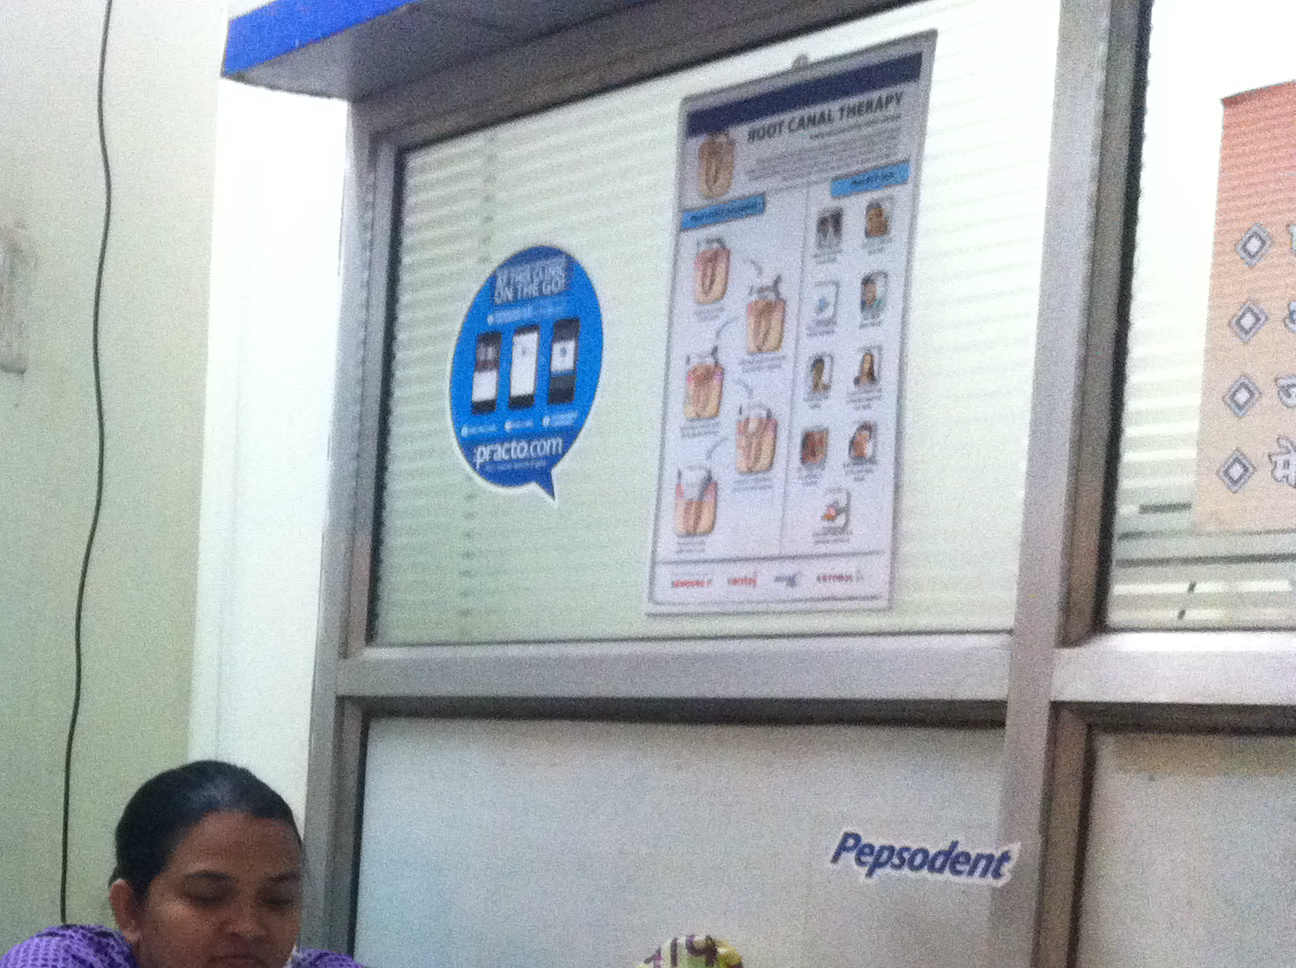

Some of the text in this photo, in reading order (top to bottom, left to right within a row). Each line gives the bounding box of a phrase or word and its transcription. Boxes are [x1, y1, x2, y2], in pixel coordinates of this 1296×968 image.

[747, 120, 785, 144] ROOT
[788, 108, 834, 134] CANAL
[838, 91, 905, 121] THERAPY
[829, 830, 1012, 880] Pepsodent
